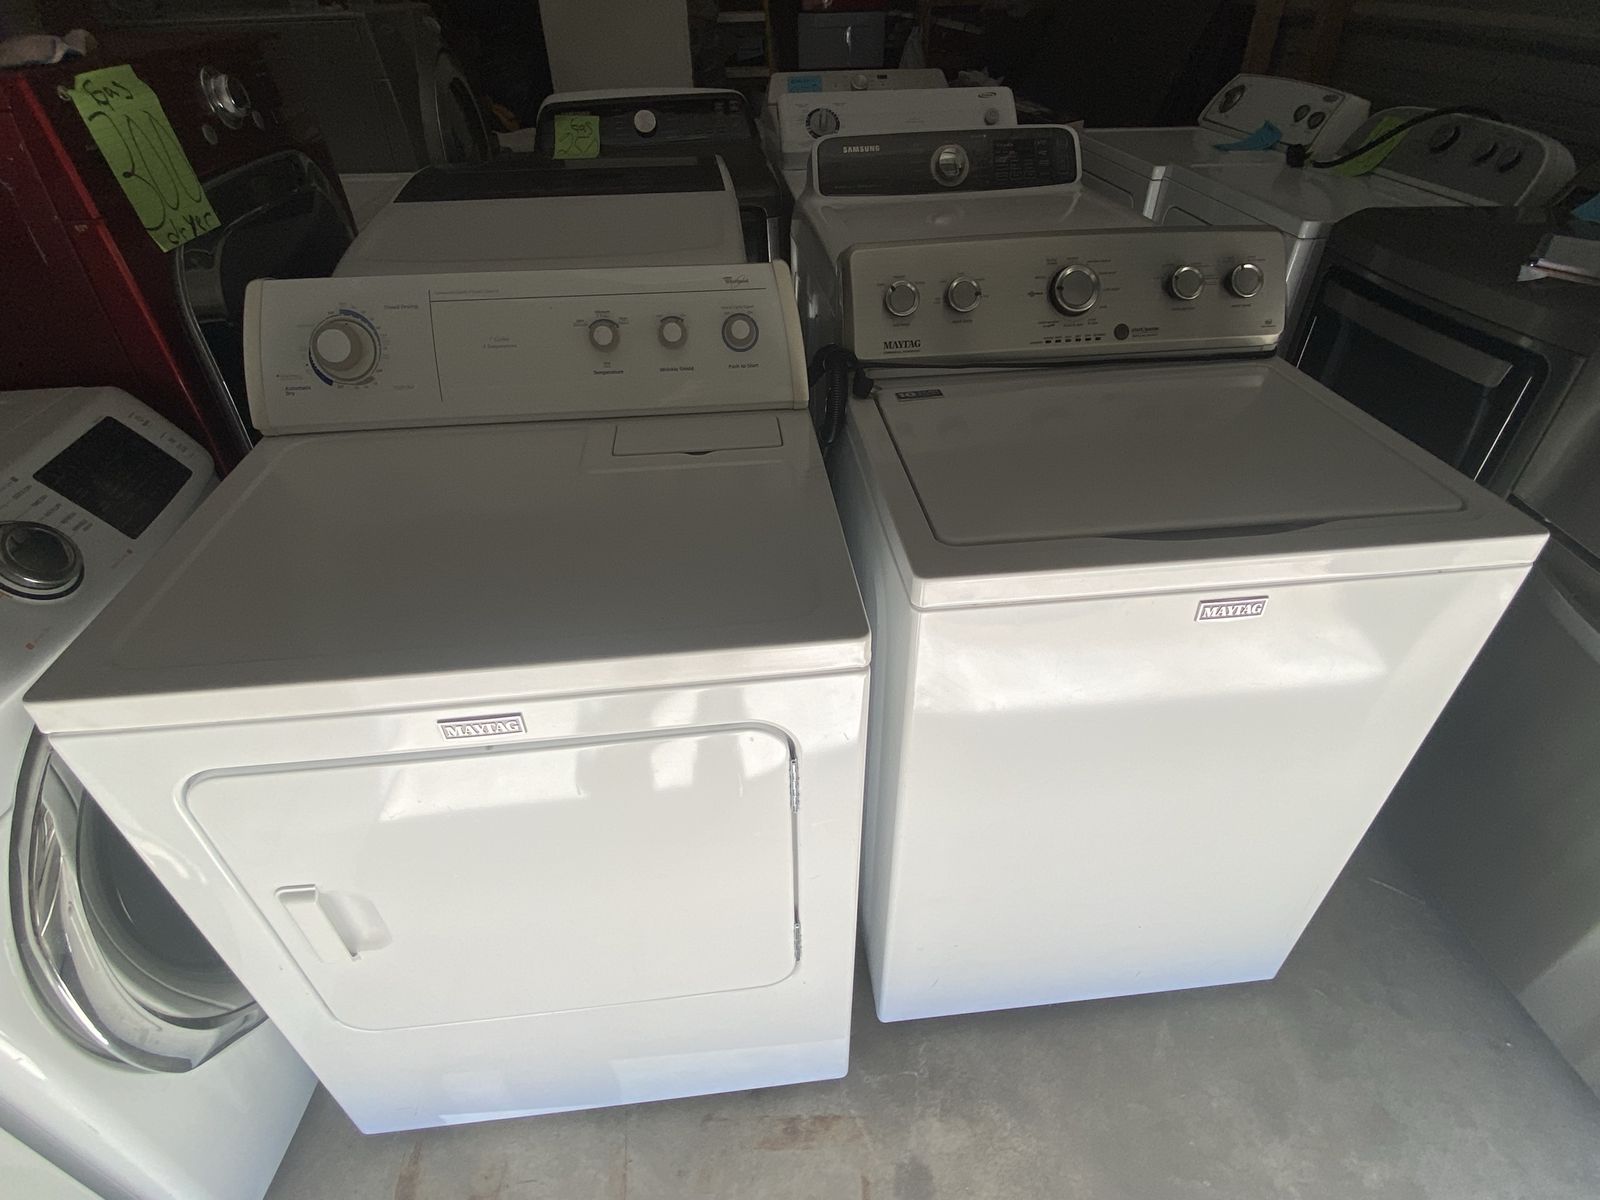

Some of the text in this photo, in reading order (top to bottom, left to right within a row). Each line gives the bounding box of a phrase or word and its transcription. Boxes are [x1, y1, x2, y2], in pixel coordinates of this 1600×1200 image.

[82, 79, 134, 112] Gas
[842, 145, 880, 154] SAMSUNG
[88, 110, 202, 231] 300
[167, 212, 212, 244] dryer
[883, 339, 921, 350] MAYTAG
[1202, 602, 1263, 618] MAYTAG
[444, 719, 520, 738] MAYTAG
